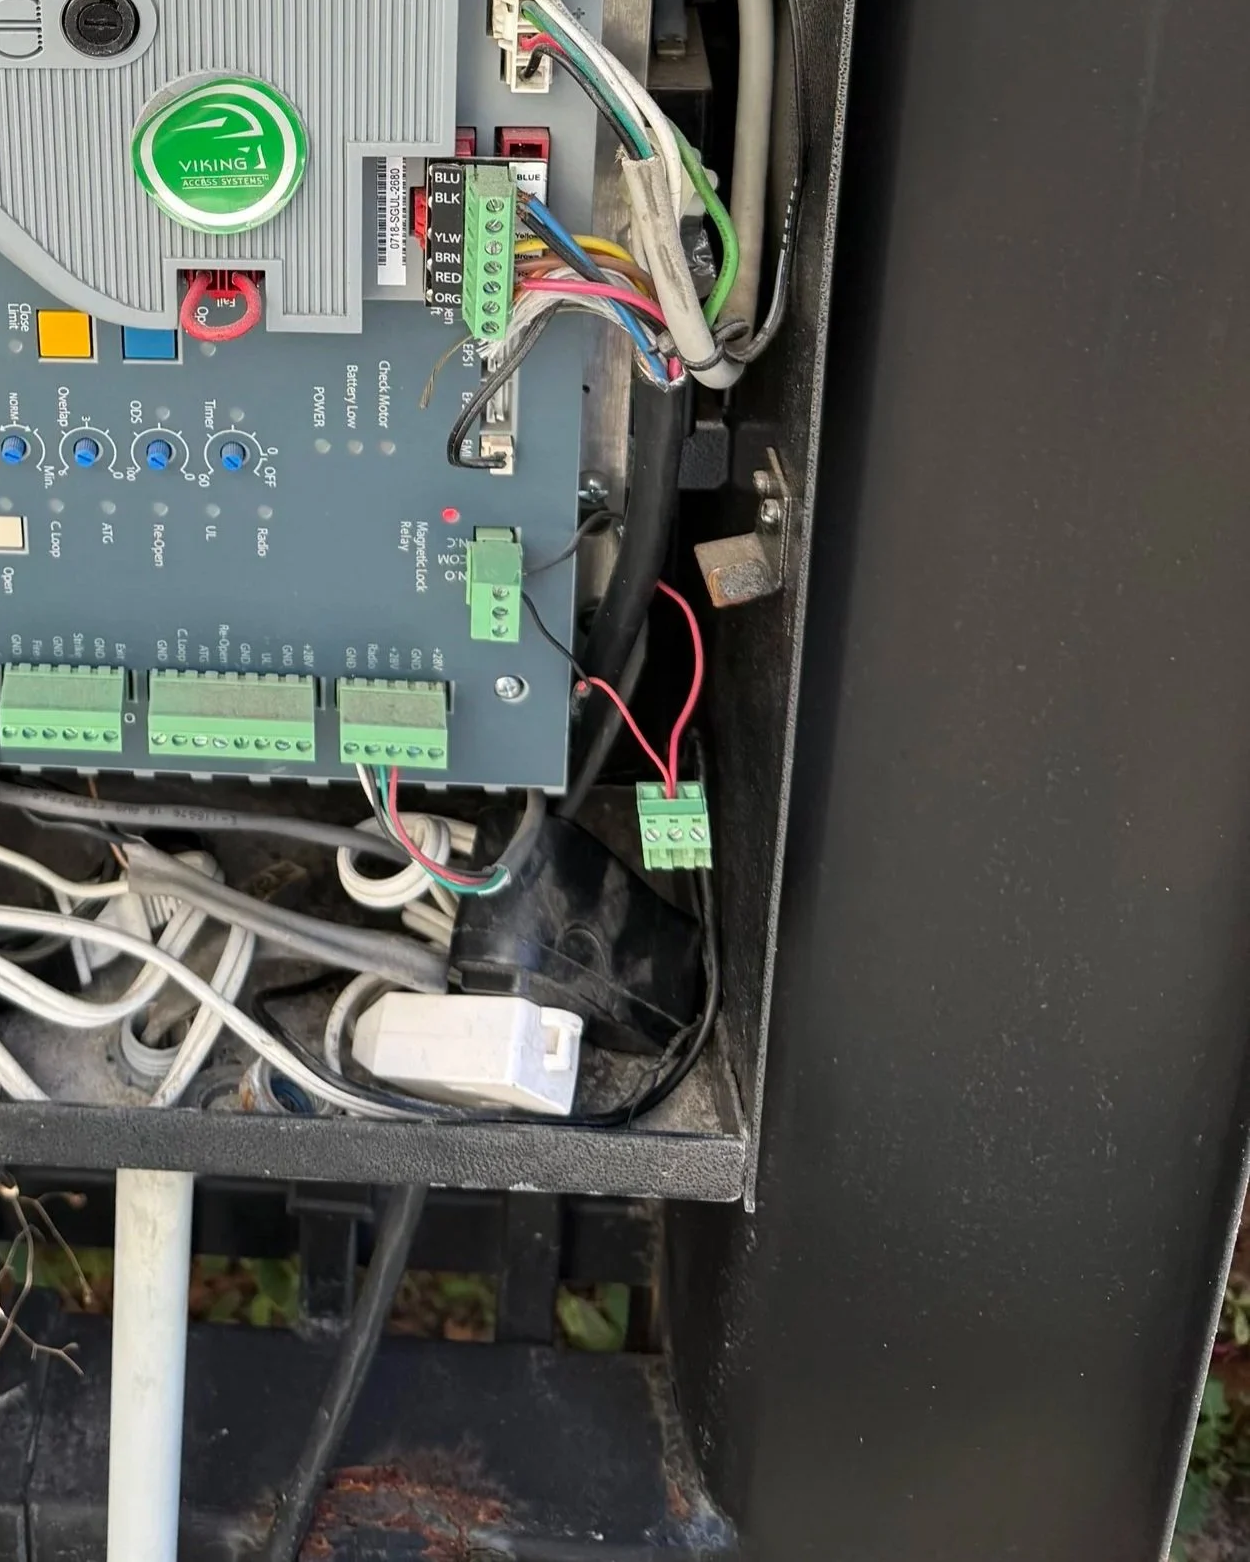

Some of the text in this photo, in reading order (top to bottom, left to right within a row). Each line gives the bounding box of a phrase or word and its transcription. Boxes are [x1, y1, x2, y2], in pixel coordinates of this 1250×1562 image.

[179, 158, 247, 173] VIKING
[183, 178, 218, 188] ACCESS
[435, 172, 460, 184] BLU
[390, 168, 400, 250] 0718-SGUL-2680
[435, 192, 461, 204] BLK
[435, 232, 461, 244] YLW
[435, 252, 461, 264] BRN
[435, 272, 462, 284] RED
[216, 298, 236, 308] Fail
[435, 293, 462, 304] ORG
[8, 303, 19, 330] Limit
[19, 302, 32, 332] Close
[463, 344, 473, 367] EPS1
[347, 364, 359, 428] Battery Low
[379, 360, 391, 428] Check Motor
[58, 386, 70, 427] Overlap
[130, 401, 142, 424] ODS
[204, 400, 216, 430] Timer
[313, 386, 325, 427] POWER
[44, 465, 56, 489] Min.
[126, 465, 137, 482] 100
[199, 473, 210, 488] 60
[265, 467, 277, 489] OFF
[50, 521, 61, 559] C Loop
[205, 525, 216, 542] UL
[258, 527, 268, 557] Radio
[398, 521, 411, 552] Relay
[153, 524, 165, 568] Re-Open
[416, 521, 428, 593] Magnetic Lock
[437, 554, 466, 565] COM
[2, 566, 15, 594] Open
